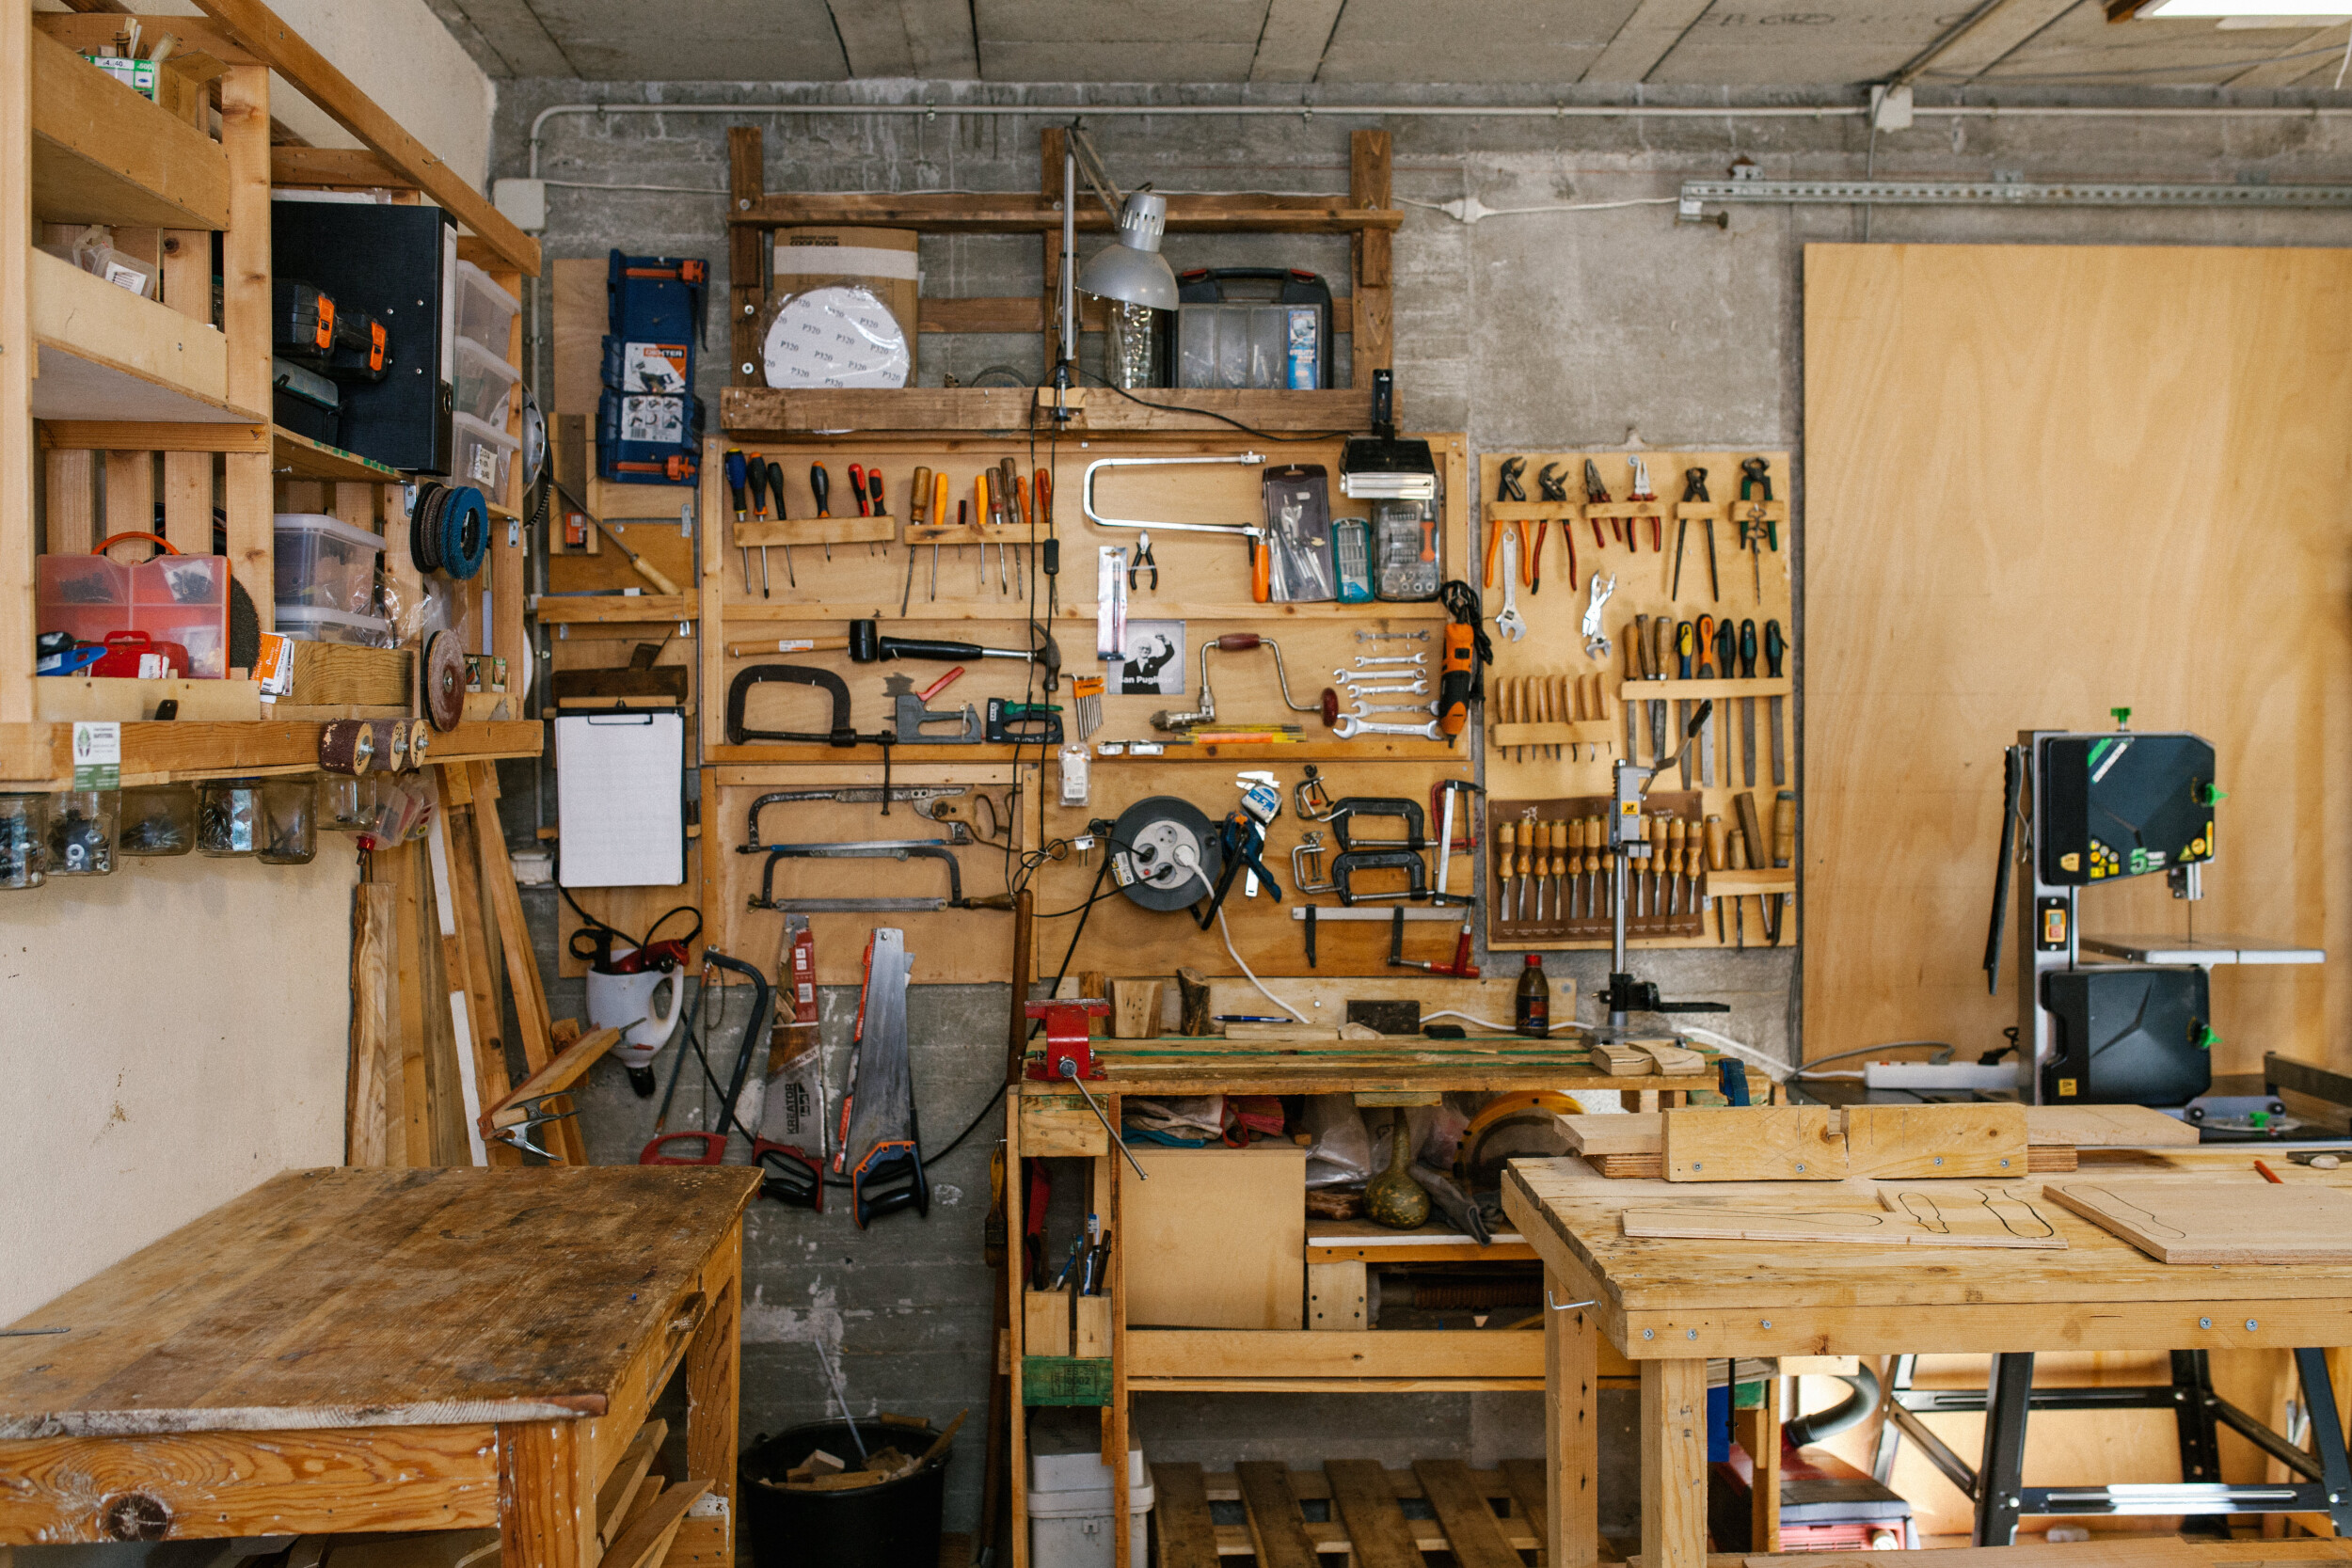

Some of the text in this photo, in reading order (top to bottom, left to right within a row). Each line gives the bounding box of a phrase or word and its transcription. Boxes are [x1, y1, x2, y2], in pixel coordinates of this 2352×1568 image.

[802, 323, 821, 335] P320
[860, 317, 878, 329] P320
[836, 333, 855, 345] P320
[780, 340, 799, 352] P320
[870, 343, 889, 355] P320
[814, 350, 833, 362] P320
[848, 360, 867, 372] P320
[791, 367, 810, 378] P320
[882, 371, 901, 382] P320
[825, 377, 843, 388] P320
[2130, 847, 2148, 875] 5
[785, 1083, 796, 1134] KREATOR
